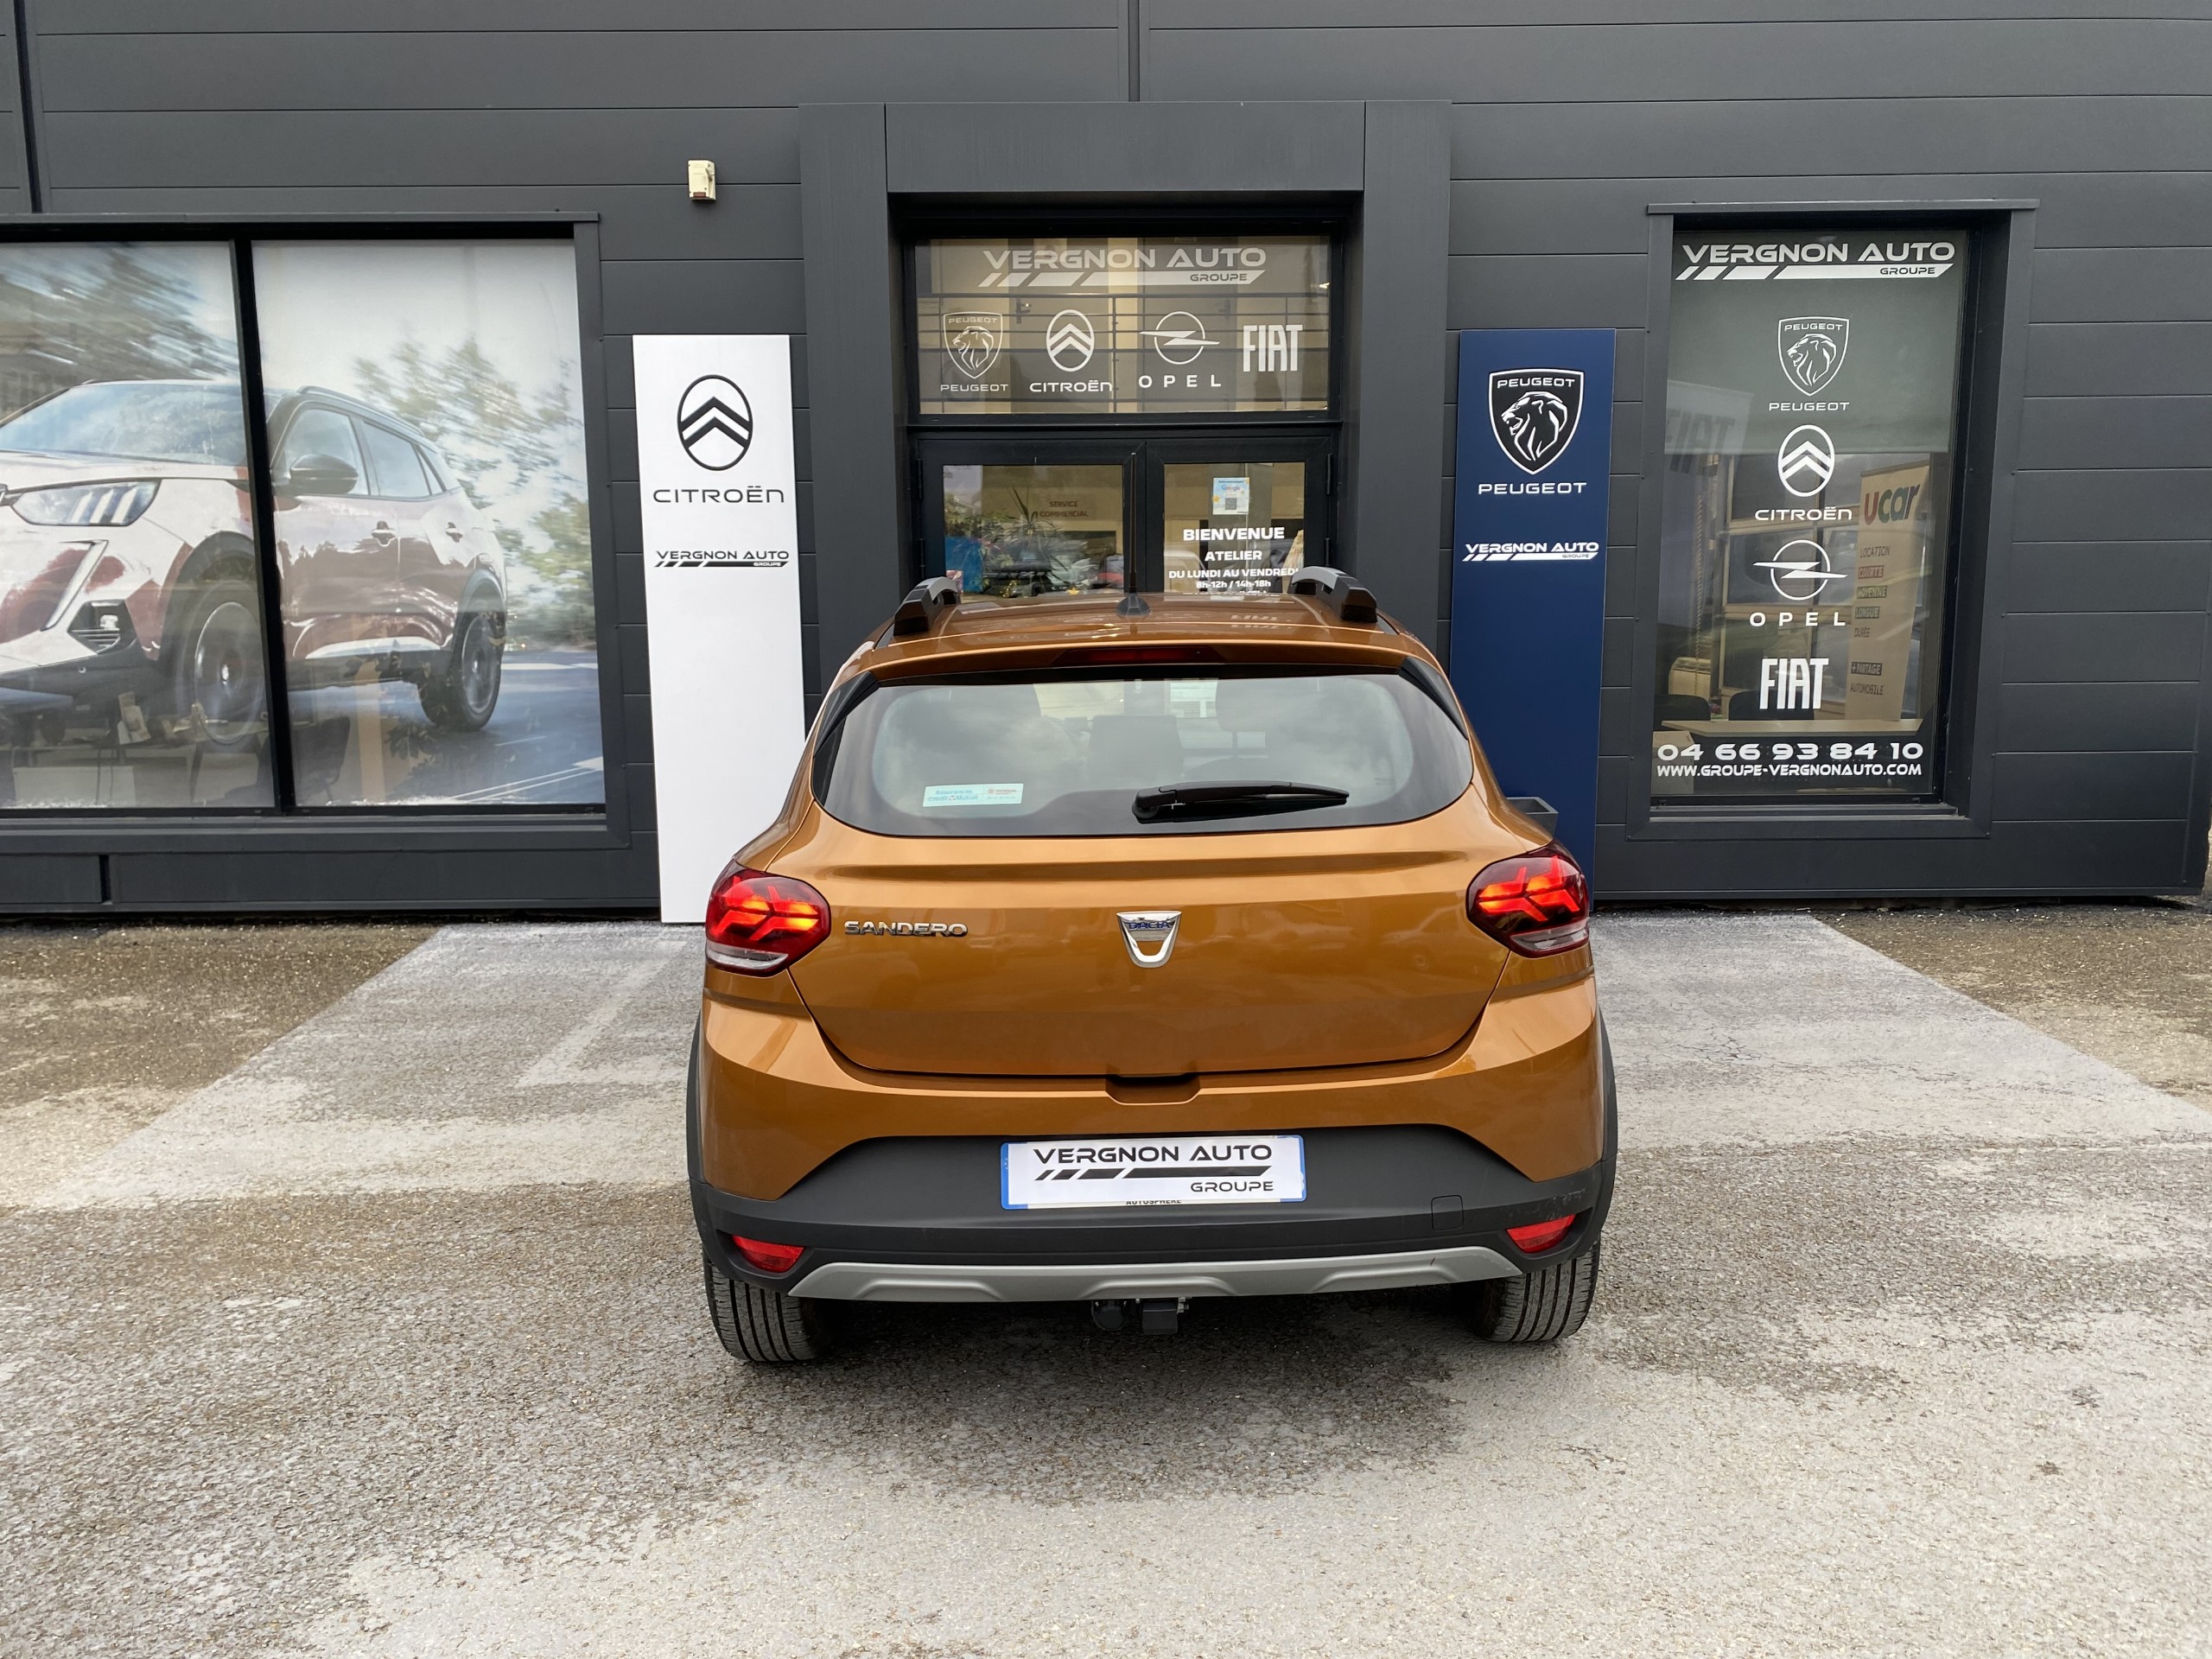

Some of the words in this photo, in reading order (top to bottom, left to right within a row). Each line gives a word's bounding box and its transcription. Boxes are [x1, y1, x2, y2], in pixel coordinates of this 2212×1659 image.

[982, 249, 1155, 270] VERGNON
[1166, 247, 1267, 268] AUTO
[1681, 243, 1848, 264] VERGNON
[1857, 241, 1955, 262] AUTO
[1879, 266, 1936, 276] GROUPE
[1189, 273, 1248, 283] GROUPE
[948, 316, 998, 325] PEUGEOT
[1783, 322, 1843, 332] PEUGEOT
[1243, 324, 1303, 372] FIAT
[940, 383, 1008, 393] PEUGEOT
[1138, 374, 1222, 389] OPEL
[1497, 377, 1575, 389] PEUGEOT
[1769, 402, 1850, 411] PEUGEOT
[1478, 482, 1587, 495] PEUGEOT
[1864, 484, 1920, 525] ucar
[1183, 527, 1285, 541] BIENVENUE
[1465, 543, 1548, 554] VERGNON
[1550, 541, 1599, 553] AUTO
[1860, 545, 1891, 558] LOCATION
[656, 550, 738, 560] VERGNON
[742, 550, 790, 560] AUTO
[1205, 550, 1262, 562] ATELIER
[1168, 570, 1185, 579] DU
[1186, 569, 1221, 578] LUNDI
[1223, 569, 1240, 577] AU
[1749, 611, 1847, 627] OPEL
[1759, 658, 1829, 709] FIAT
[1656, 743, 1705, 760] 04
[1714, 743, 1762, 760] 66
[1771, 742, 1820, 760] 93
[1829, 742, 1878, 760] 84
[1890, 742, 1923, 760] 10
[1656, 763, 1922, 778] WWW.GROUPE-VERGNONAUTO.COM
[843, 920, 969, 938] SANDERO
[1128, 920, 1170, 930] DACIA
[1033, 1146, 1179, 1164] VERGNON
[1189, 1144, 1273, 1161] AUTO
[1190, 1181, 1274, 1192] GROUPE
